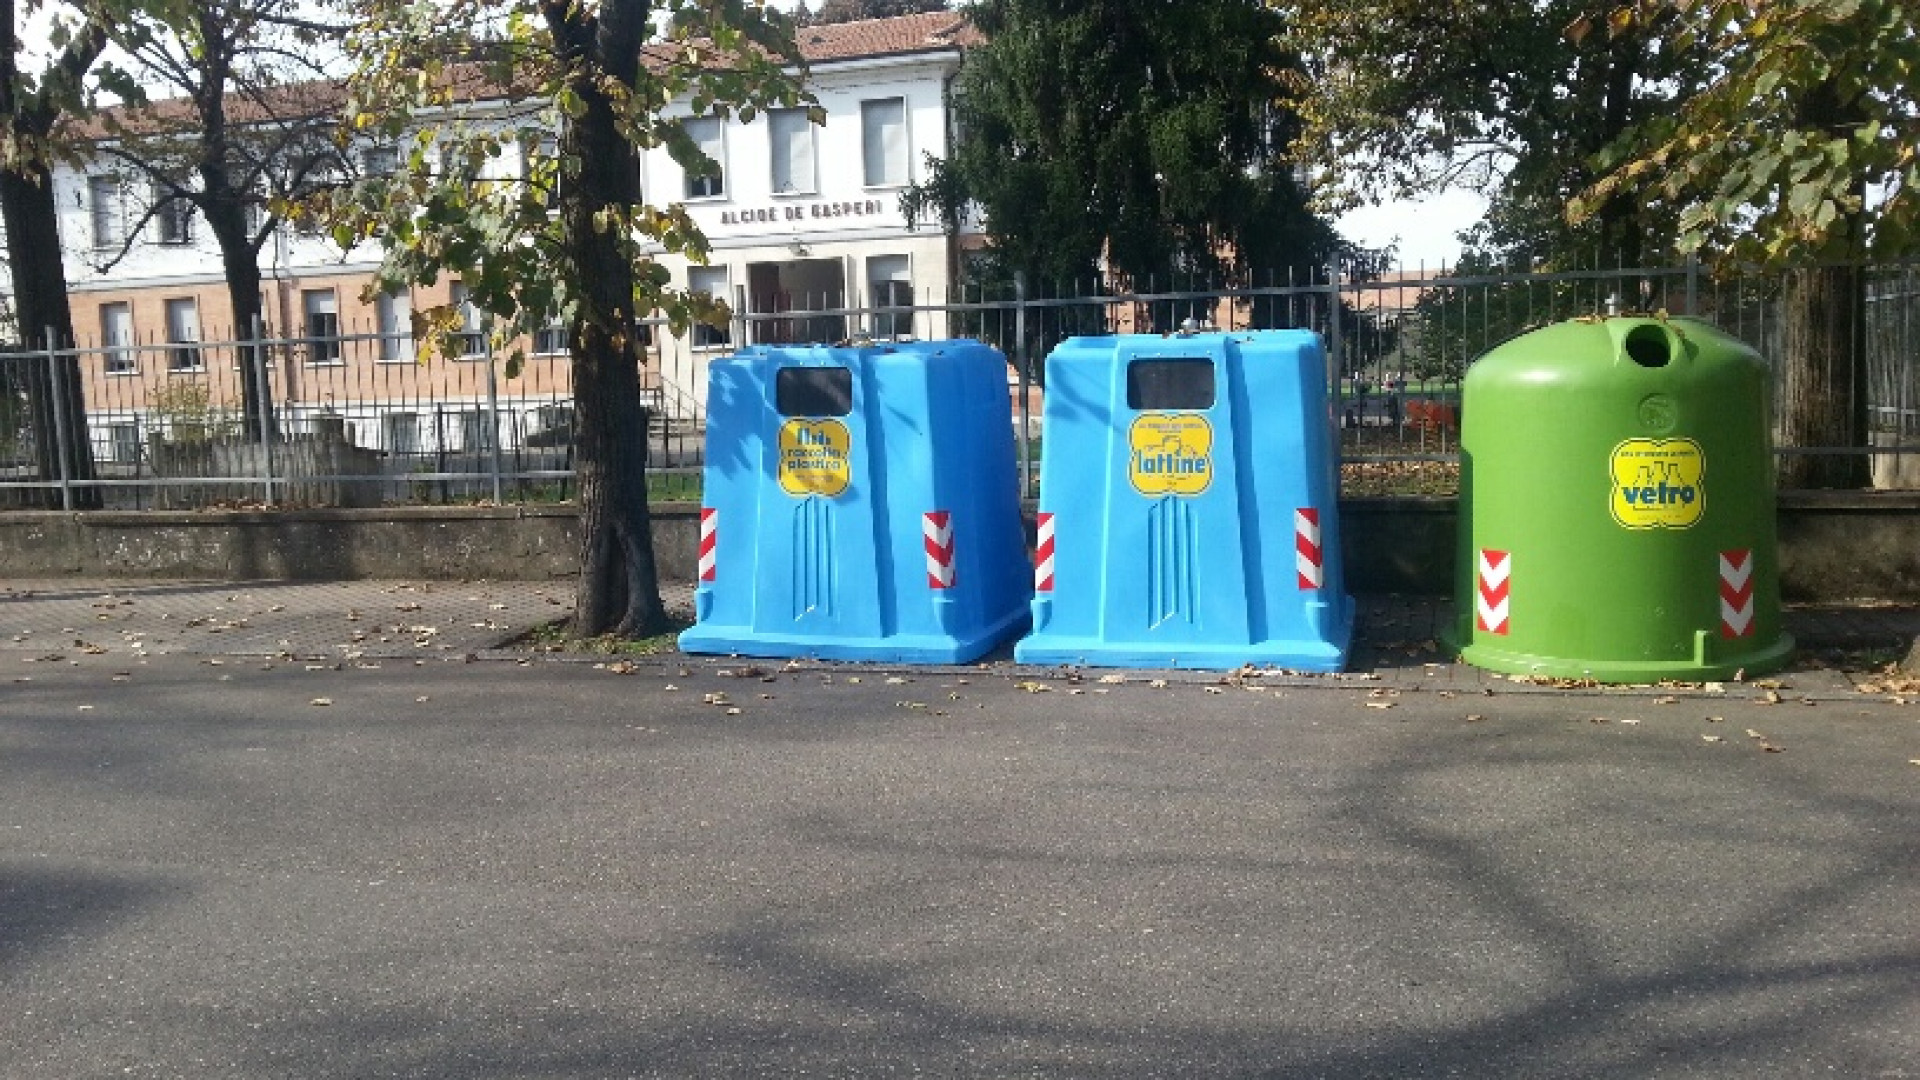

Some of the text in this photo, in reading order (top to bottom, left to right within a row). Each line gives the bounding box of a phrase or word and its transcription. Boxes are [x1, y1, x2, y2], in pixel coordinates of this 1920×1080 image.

[785, 206, 803, 221] DE
[811, 200, 882, 218] GASPERI
[1138, 449, 1206, 473] lattine
[1621, 482, 1695, 504] vetro
